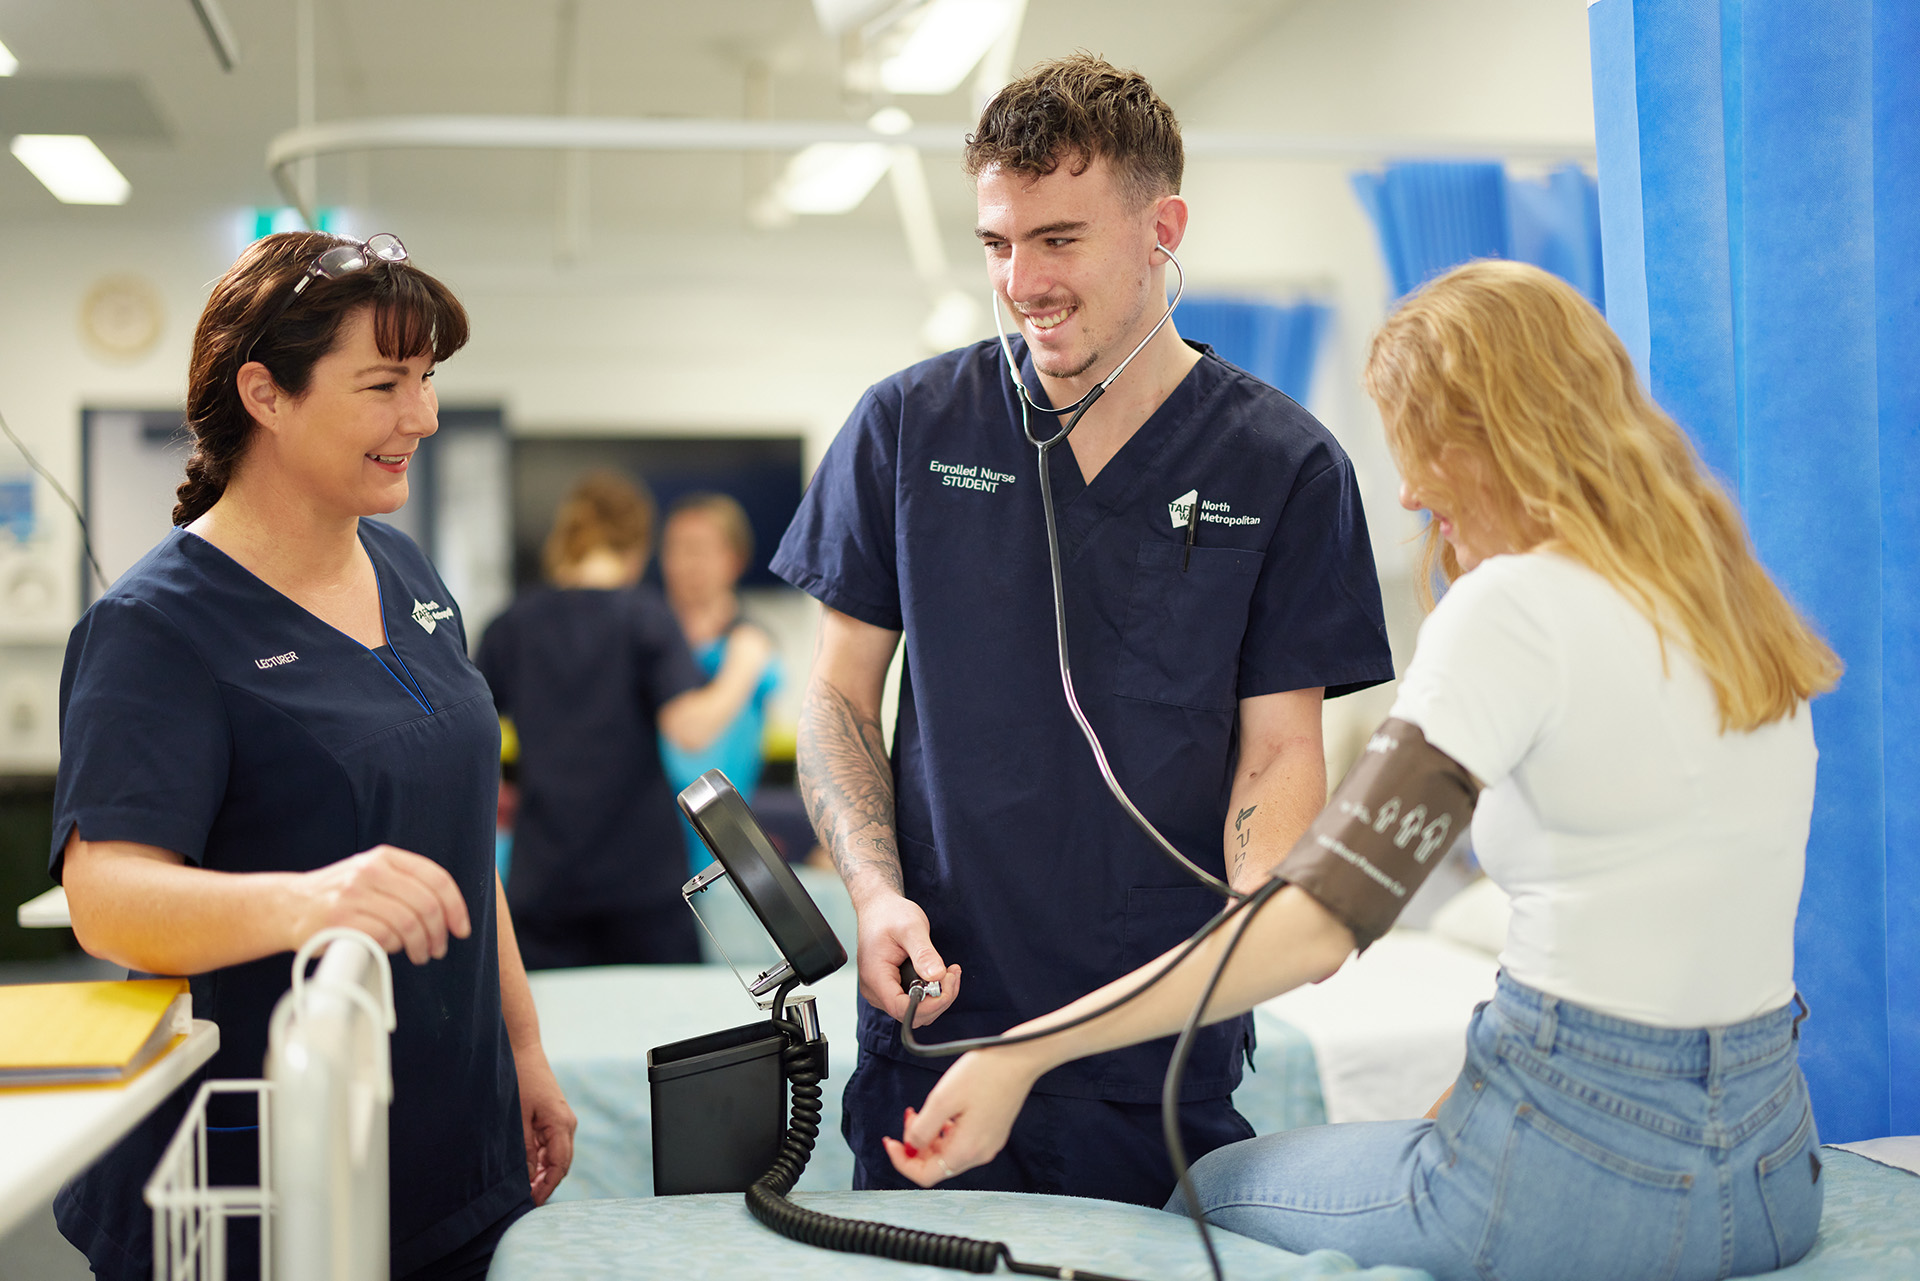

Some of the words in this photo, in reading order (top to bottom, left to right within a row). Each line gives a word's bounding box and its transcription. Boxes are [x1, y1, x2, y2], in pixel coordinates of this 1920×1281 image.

[930, 460, 977, 477] Enrolled
[980, 467, 1016, 483] Nurse
[942, 475, 999, 493] STUDENT
[1169, 503, 1191, 513] TAF
[1201, 500, 1230, 512] North
[1200, 512, 1261, 527] Metropolitan
[254, 651, 299, 669] LECTURER
